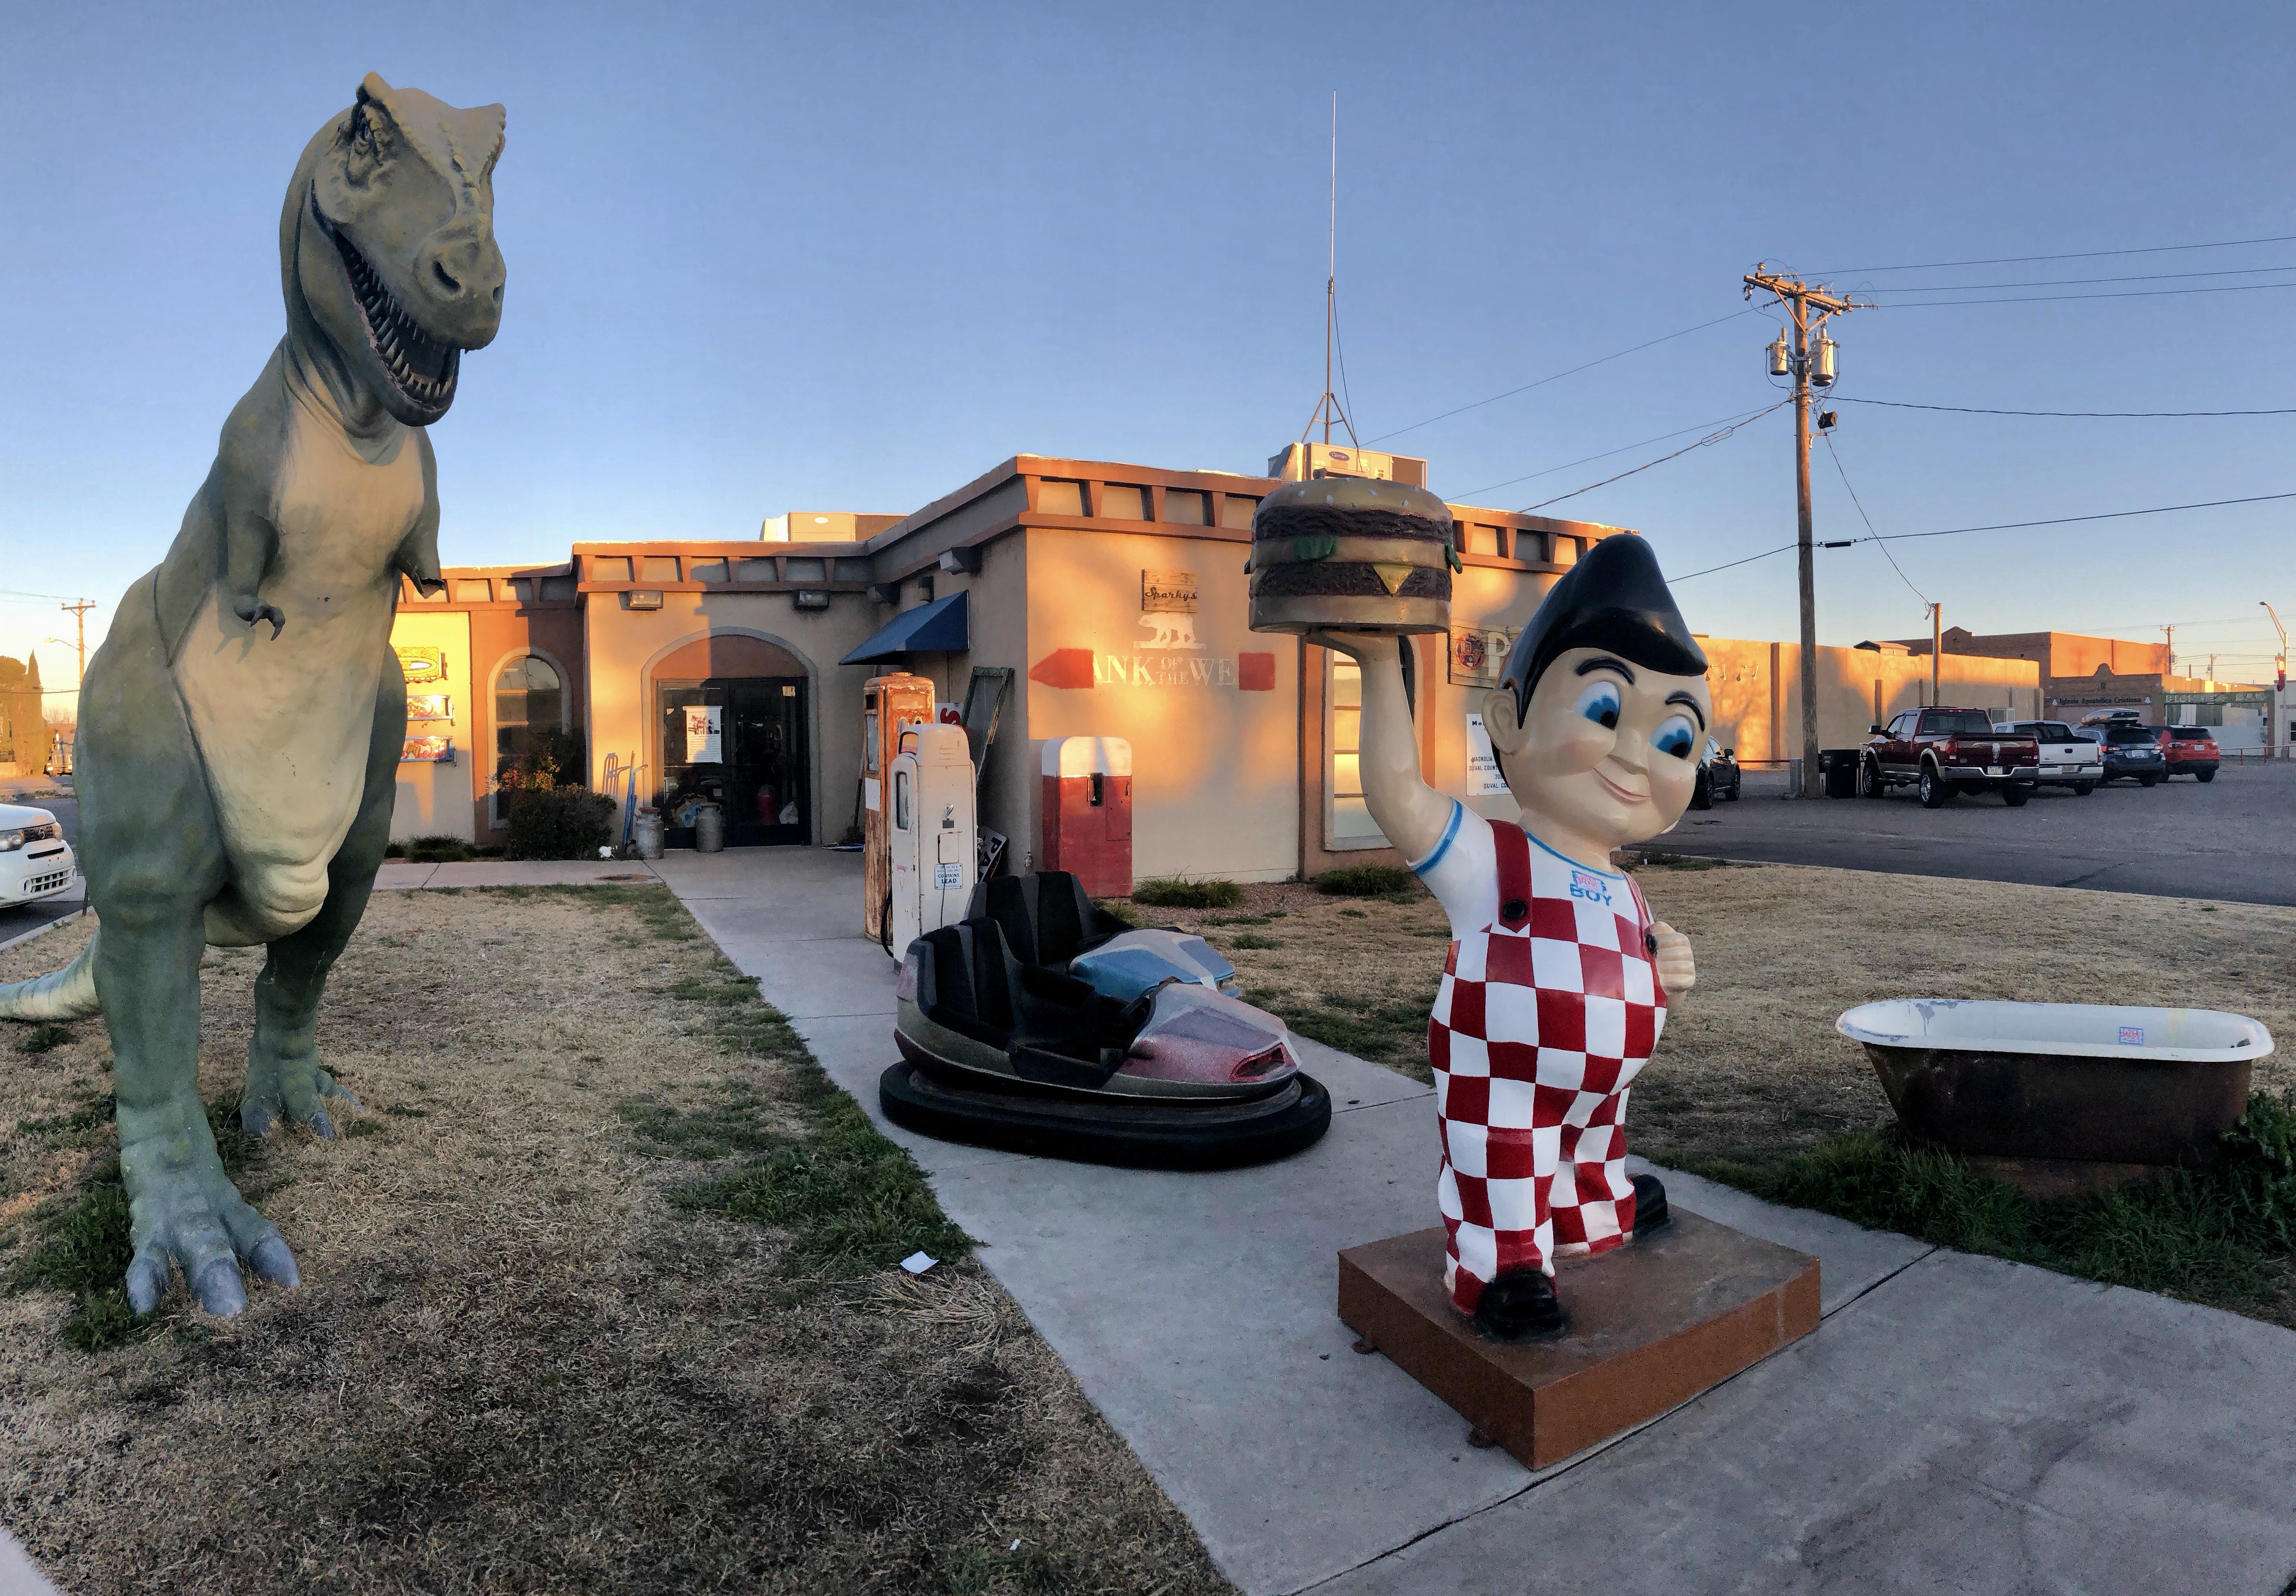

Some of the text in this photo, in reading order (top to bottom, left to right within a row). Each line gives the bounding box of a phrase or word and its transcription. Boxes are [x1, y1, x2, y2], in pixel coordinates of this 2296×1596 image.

[1093, 655, 1238, 689] ANK OF THE WE
